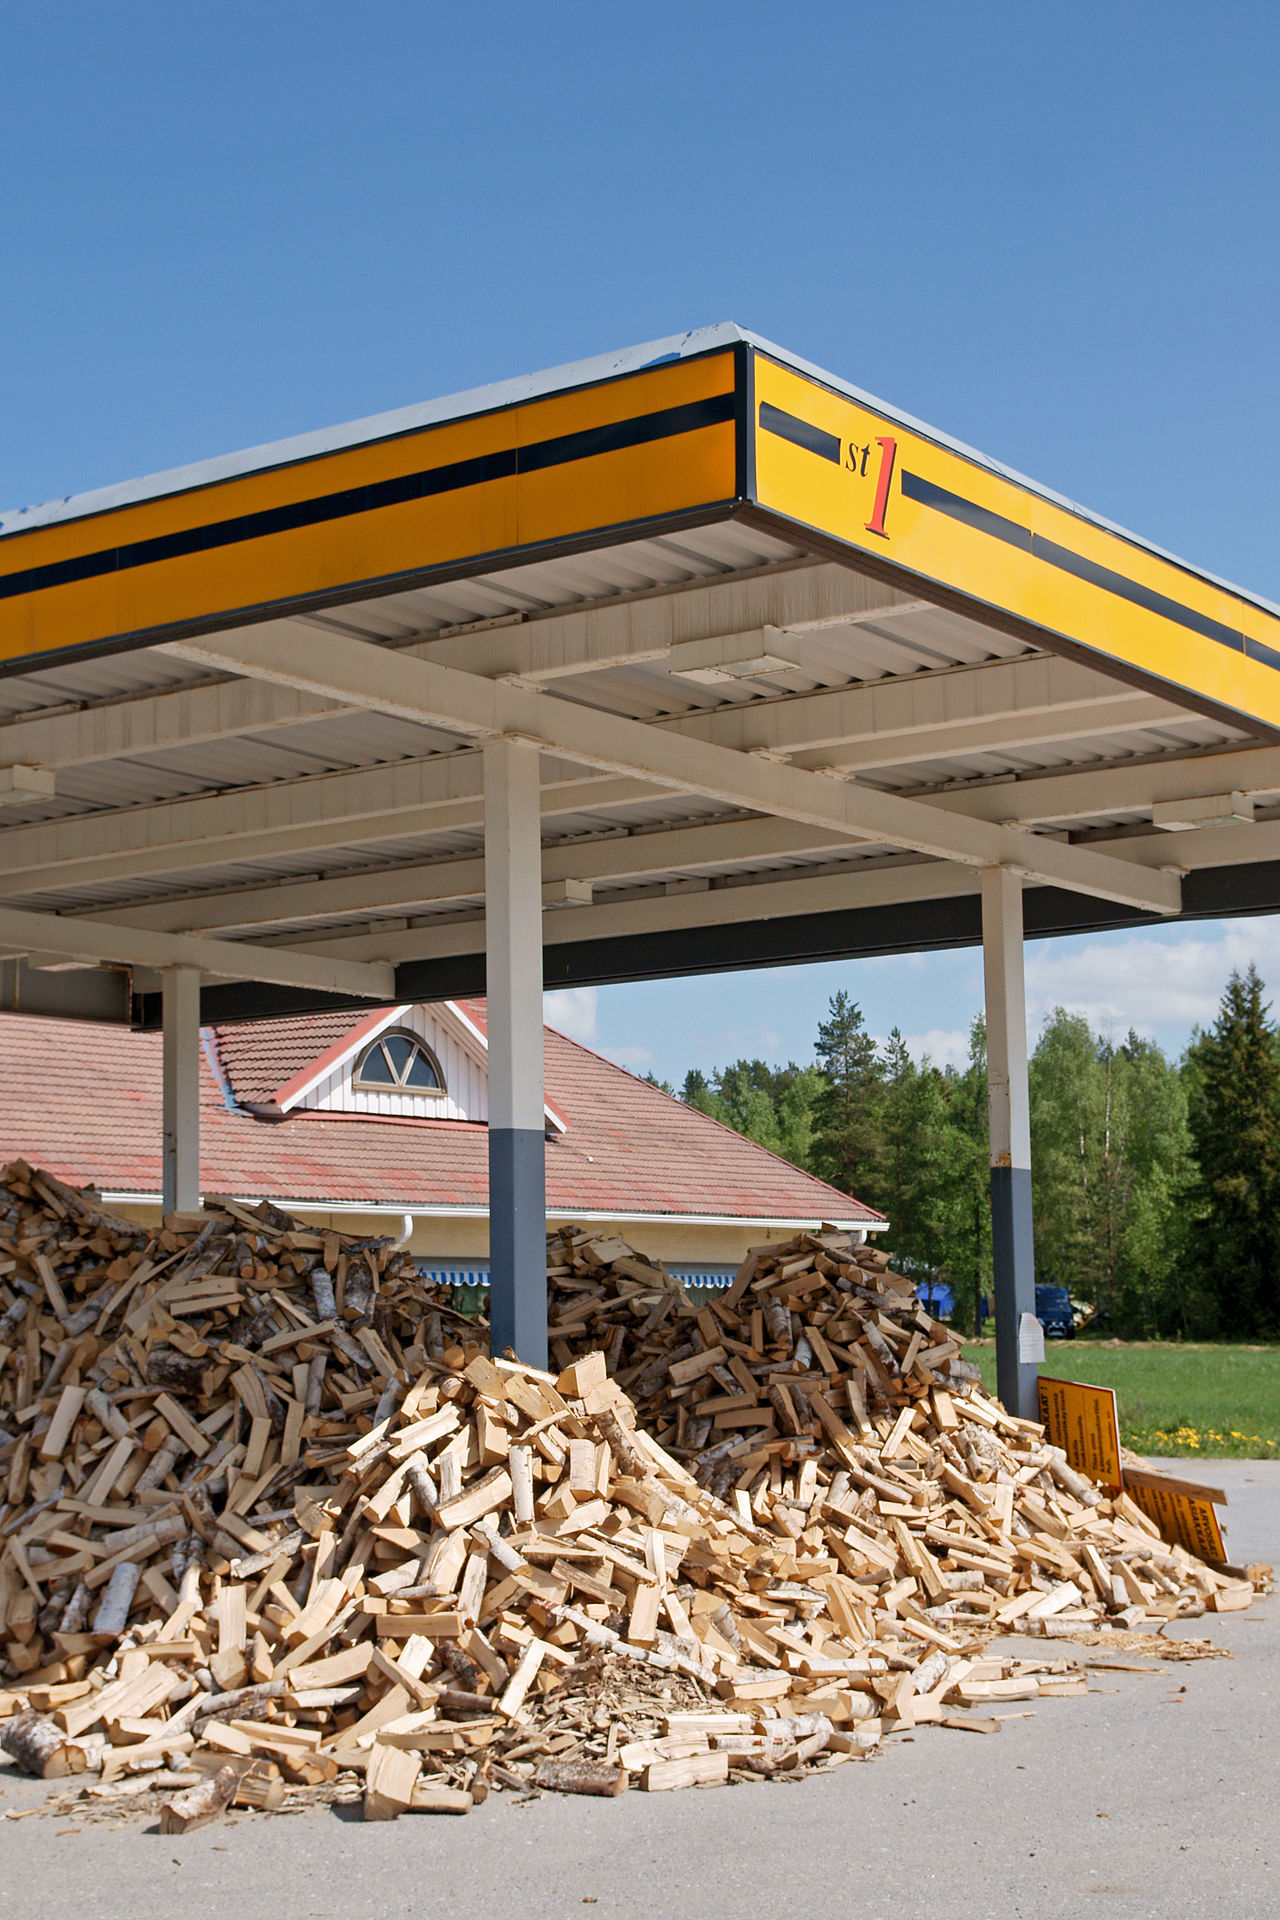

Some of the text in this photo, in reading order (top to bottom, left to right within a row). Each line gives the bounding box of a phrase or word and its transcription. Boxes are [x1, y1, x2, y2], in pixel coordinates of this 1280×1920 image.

[846, 437, 897, 540] st1
[1188, 1498, 1209, 1557] ASIAKKAAT
[1199, 1507, 1218, 1556] ARVOISAT
